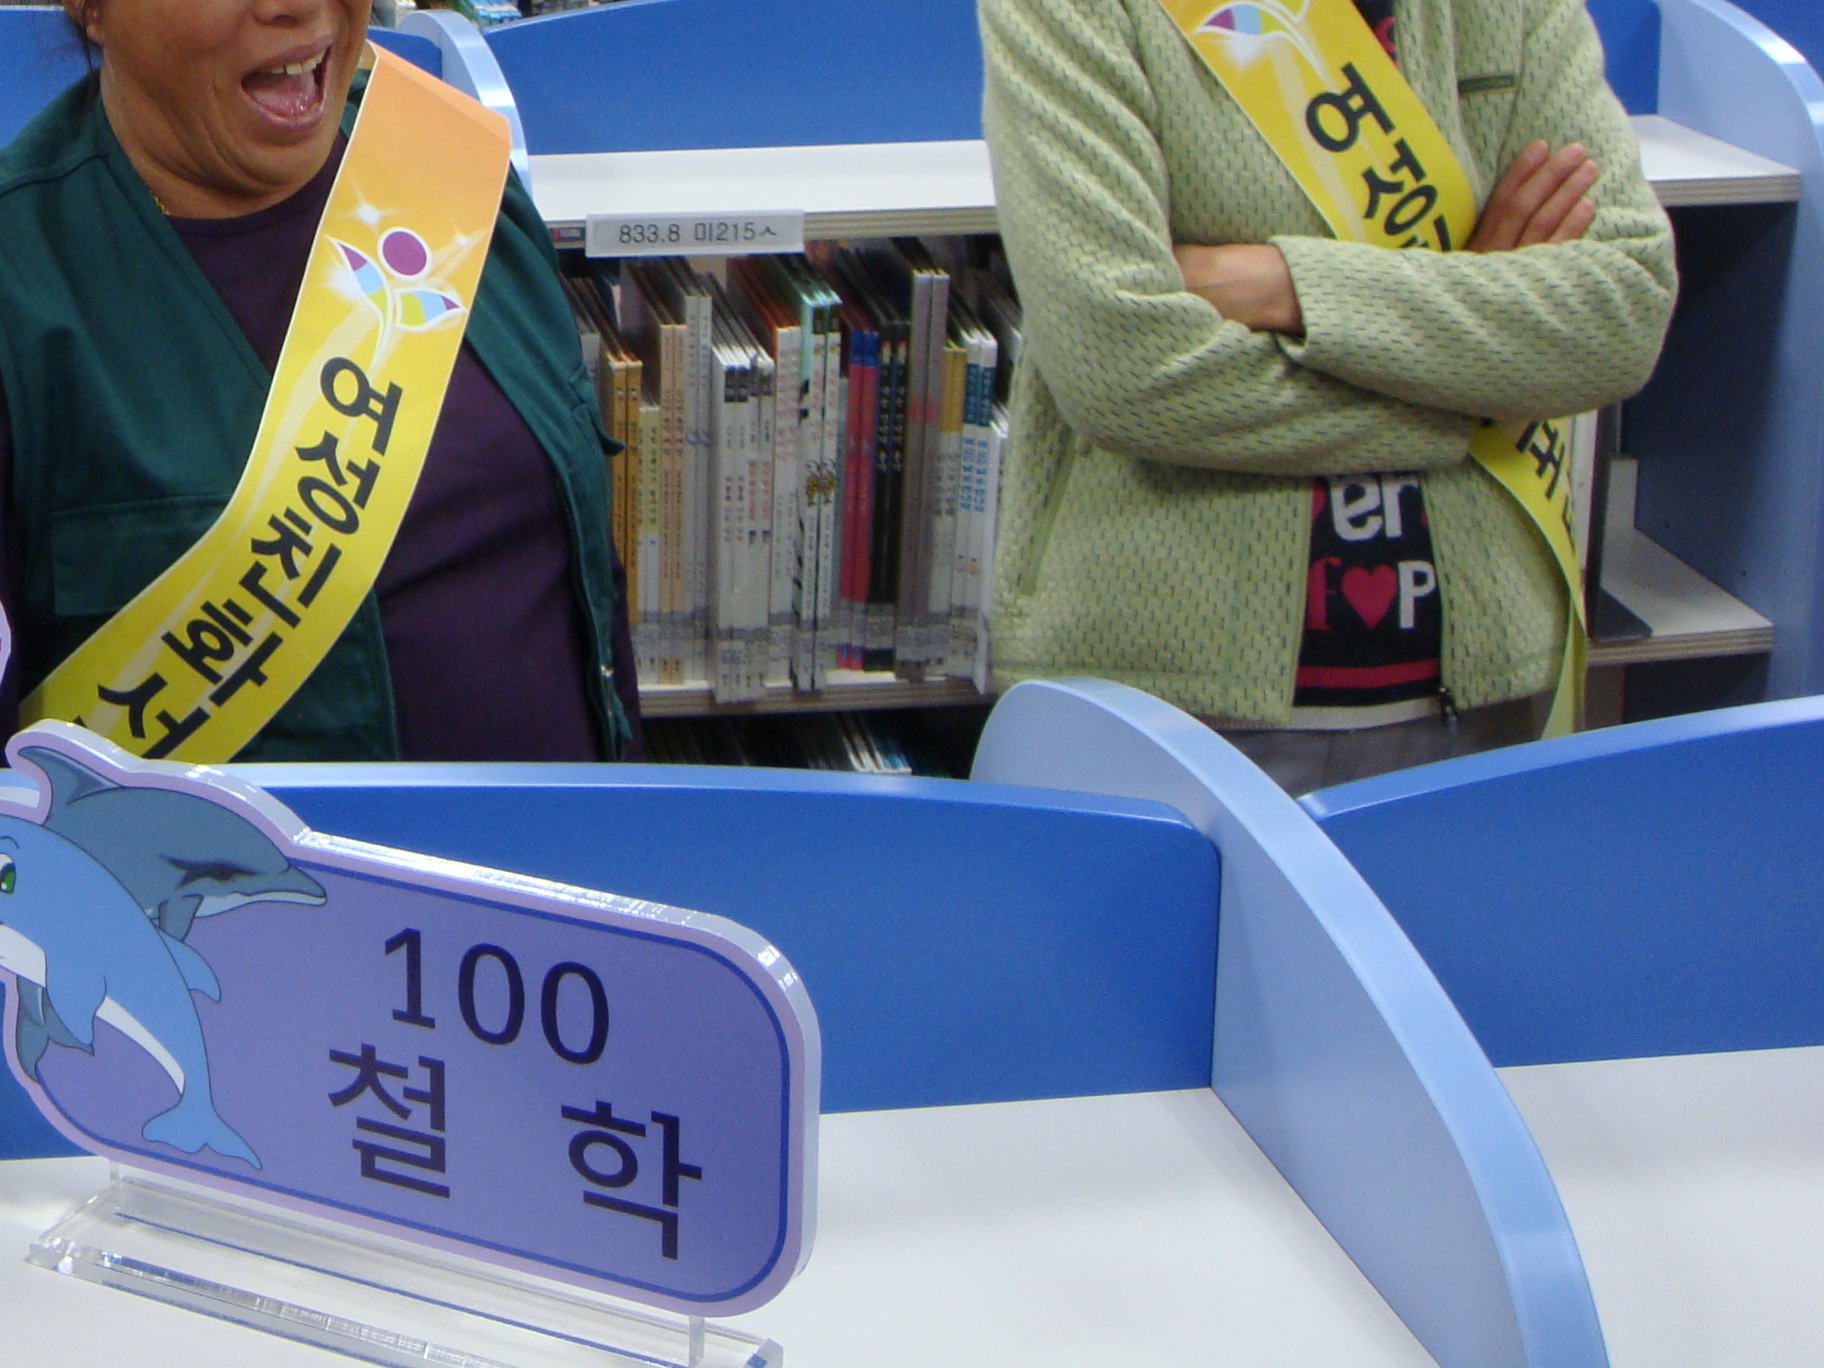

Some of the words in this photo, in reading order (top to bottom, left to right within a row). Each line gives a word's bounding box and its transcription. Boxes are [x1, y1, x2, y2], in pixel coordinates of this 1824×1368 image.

[1305, 60, 1452, 252] 여성
[618, 223, 681, 244] 833.8
[384, 927, 610, 1065] 100
